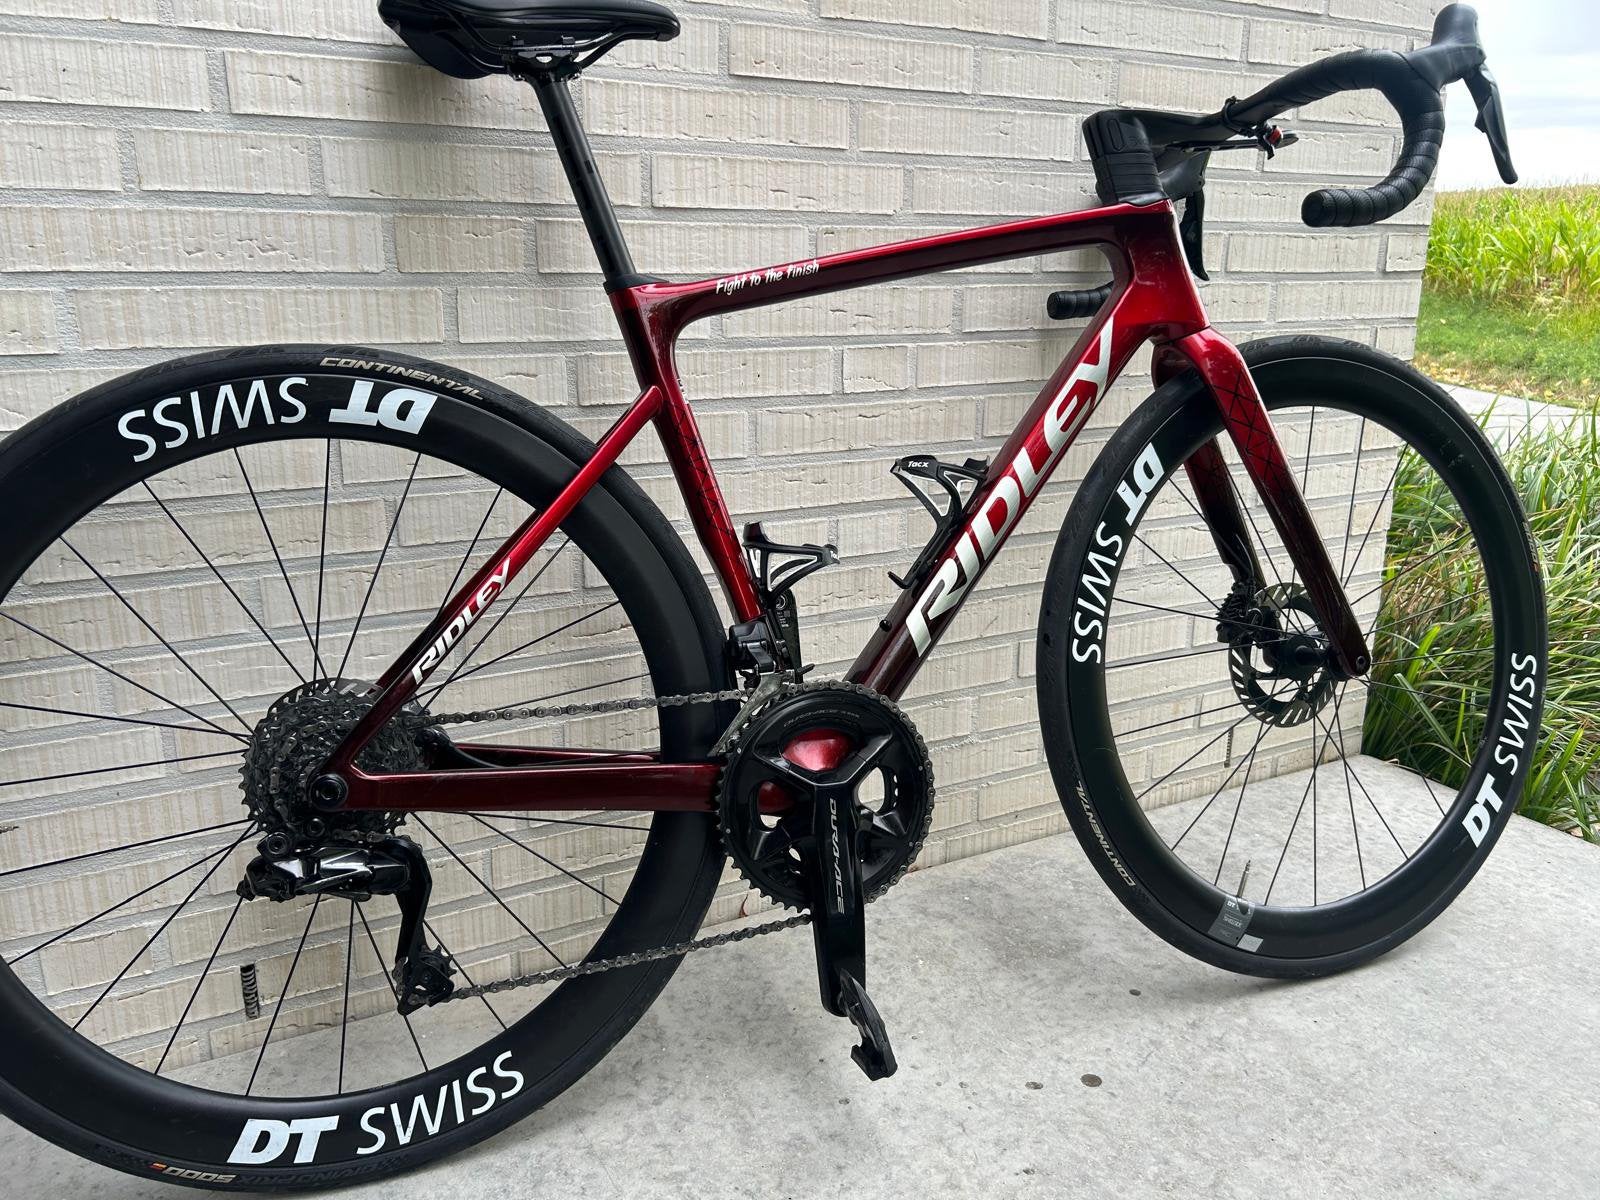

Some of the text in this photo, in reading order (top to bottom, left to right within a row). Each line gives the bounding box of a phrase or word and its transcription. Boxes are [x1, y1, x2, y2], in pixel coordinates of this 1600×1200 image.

[715, 259, 820, 296] Fight to the finish
[117, 376, 439, 463] DT SWISS
[320, 356, 484, 401] CONTINENTAL
[906, 317, 1115, 658] RIDLEY
[907, 460, 930, 468] Tacx
[1071, 441, 1165, 664] DT SWISS
[411, 556, 512, 685] RIDLEY
[1461, 652, 1537, 848] DT SWISS
[828, 797, 846, 915] DURA-ACE
[1075, 780, 1137, 888] CONTINENTAL
[226, 1050, 525, 1165] DT SWISS
